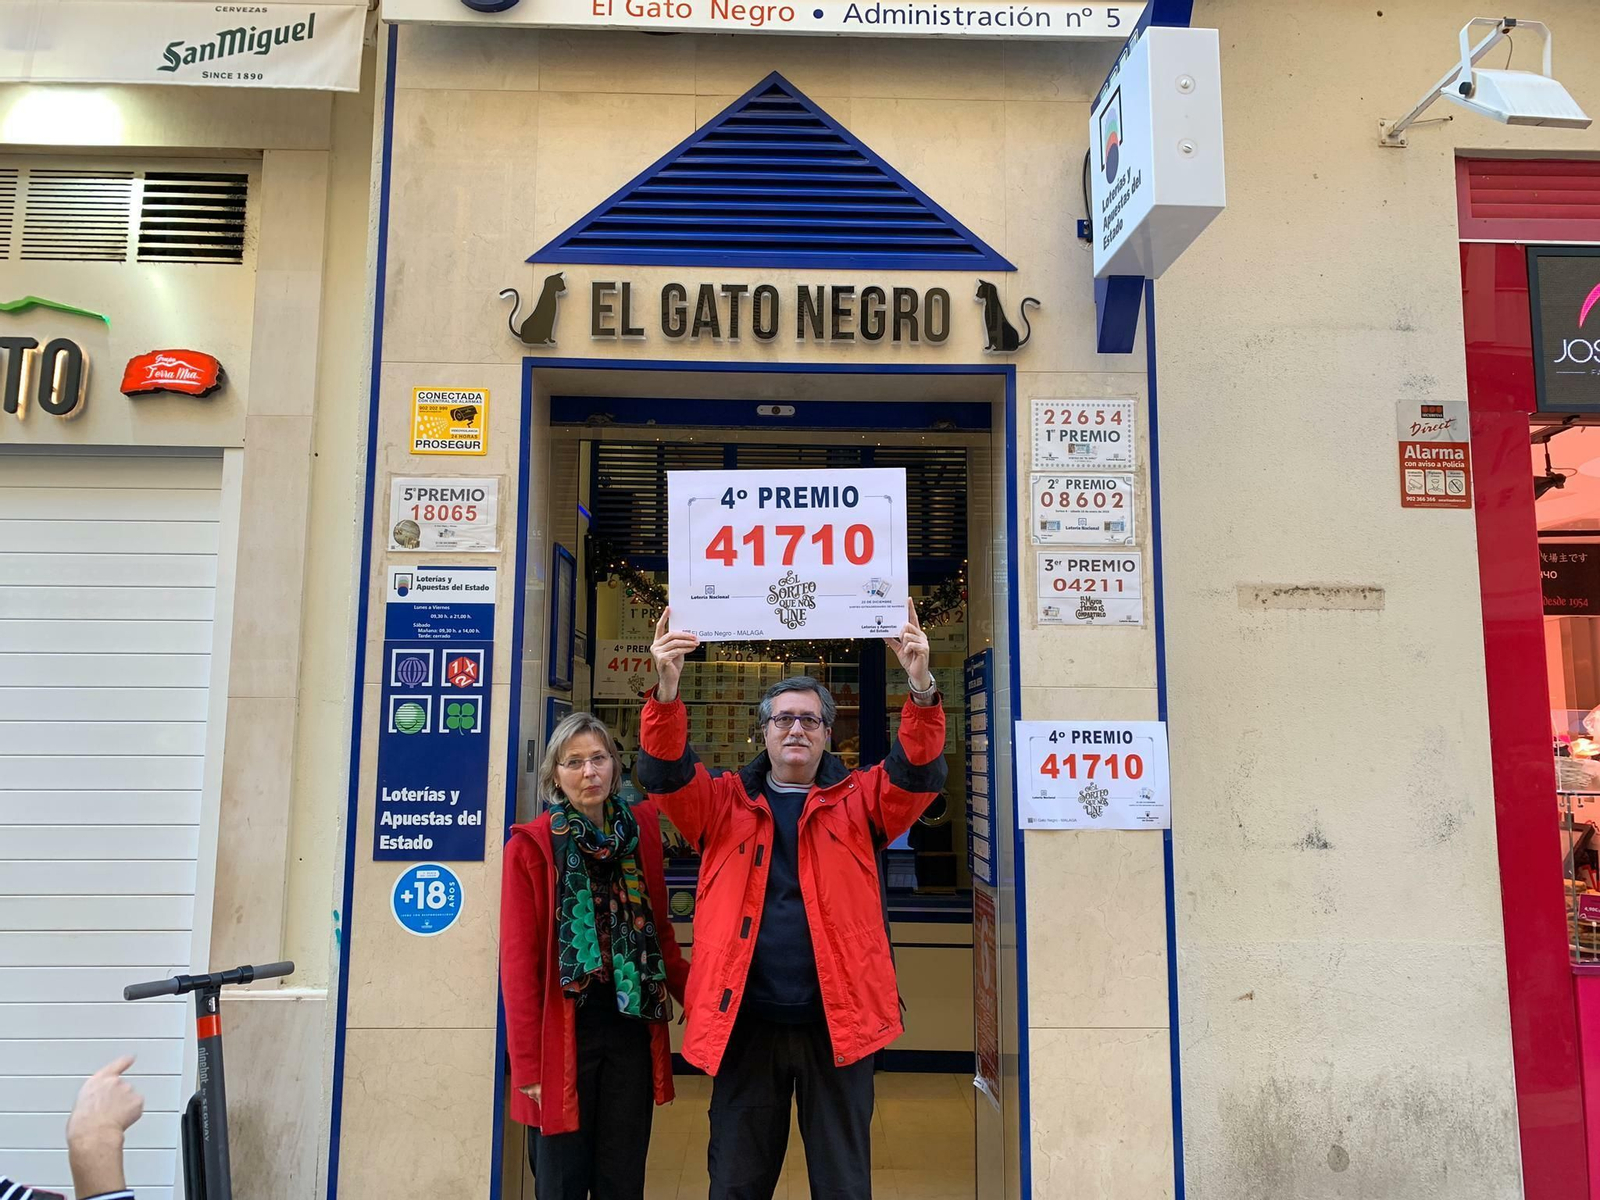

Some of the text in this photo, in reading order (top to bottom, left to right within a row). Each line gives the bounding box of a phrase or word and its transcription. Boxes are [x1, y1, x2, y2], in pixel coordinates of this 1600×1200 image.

[592, 0, 613, 16] El
[626, 0, 692, 18] Gato
[711, 0, 794, 26] Negro
[843, 3, 1050, 28] Administración
[1108, 9, 1121, 28] 5
[202, 71, 233, 79] SINCE
[1102, 166, 1132, 213] Loterías y
[1102, 169, 1142, 232] Apuestas del
[1103, 217, 1124, 251] Estado
[591, 281, 952, 344] EL GATO NEGRO
[146, 366, 174, 378] Terra
[418, 392, 482, 400] CONECTADA
[1044, 409, 1122, 426] 22654
[1410, 419, 1456, 436] Direct
[1060, 430, 1120, 442] PREMIO
[416, 440, 480, 449] PROSEGUR
[1404, 444, 1464, 460] Alarma
[1066, 479, 1117, 490] PREMIO
[417, 488, 485, 502] PREMIO
[720, 486, 860, 510] 4º PREMIO
[1041, 492, 1124, 508] 08602
[411, 504, 477, 521] 18065
[706, 524, 874, 566] 41710
[1044, 559, 1136, 572] 3er PREMIO
[1053, 578, 1123, 592] 04211
[766, 582, 817, 605] SORTEO
[1543, 596, 1566, 606] desde
[608, 657, 658, 672] 4171
[1049, 730, 1133, 744] 4º PREMIO
[1040, 754, 1143, 780] 41710
[382, 787, 460, 805] Loterías y
[380, 810, 482, 829] Apuestas del
[380, 834, 433, 850] Estado
[401, 881, 447, 910] +18
